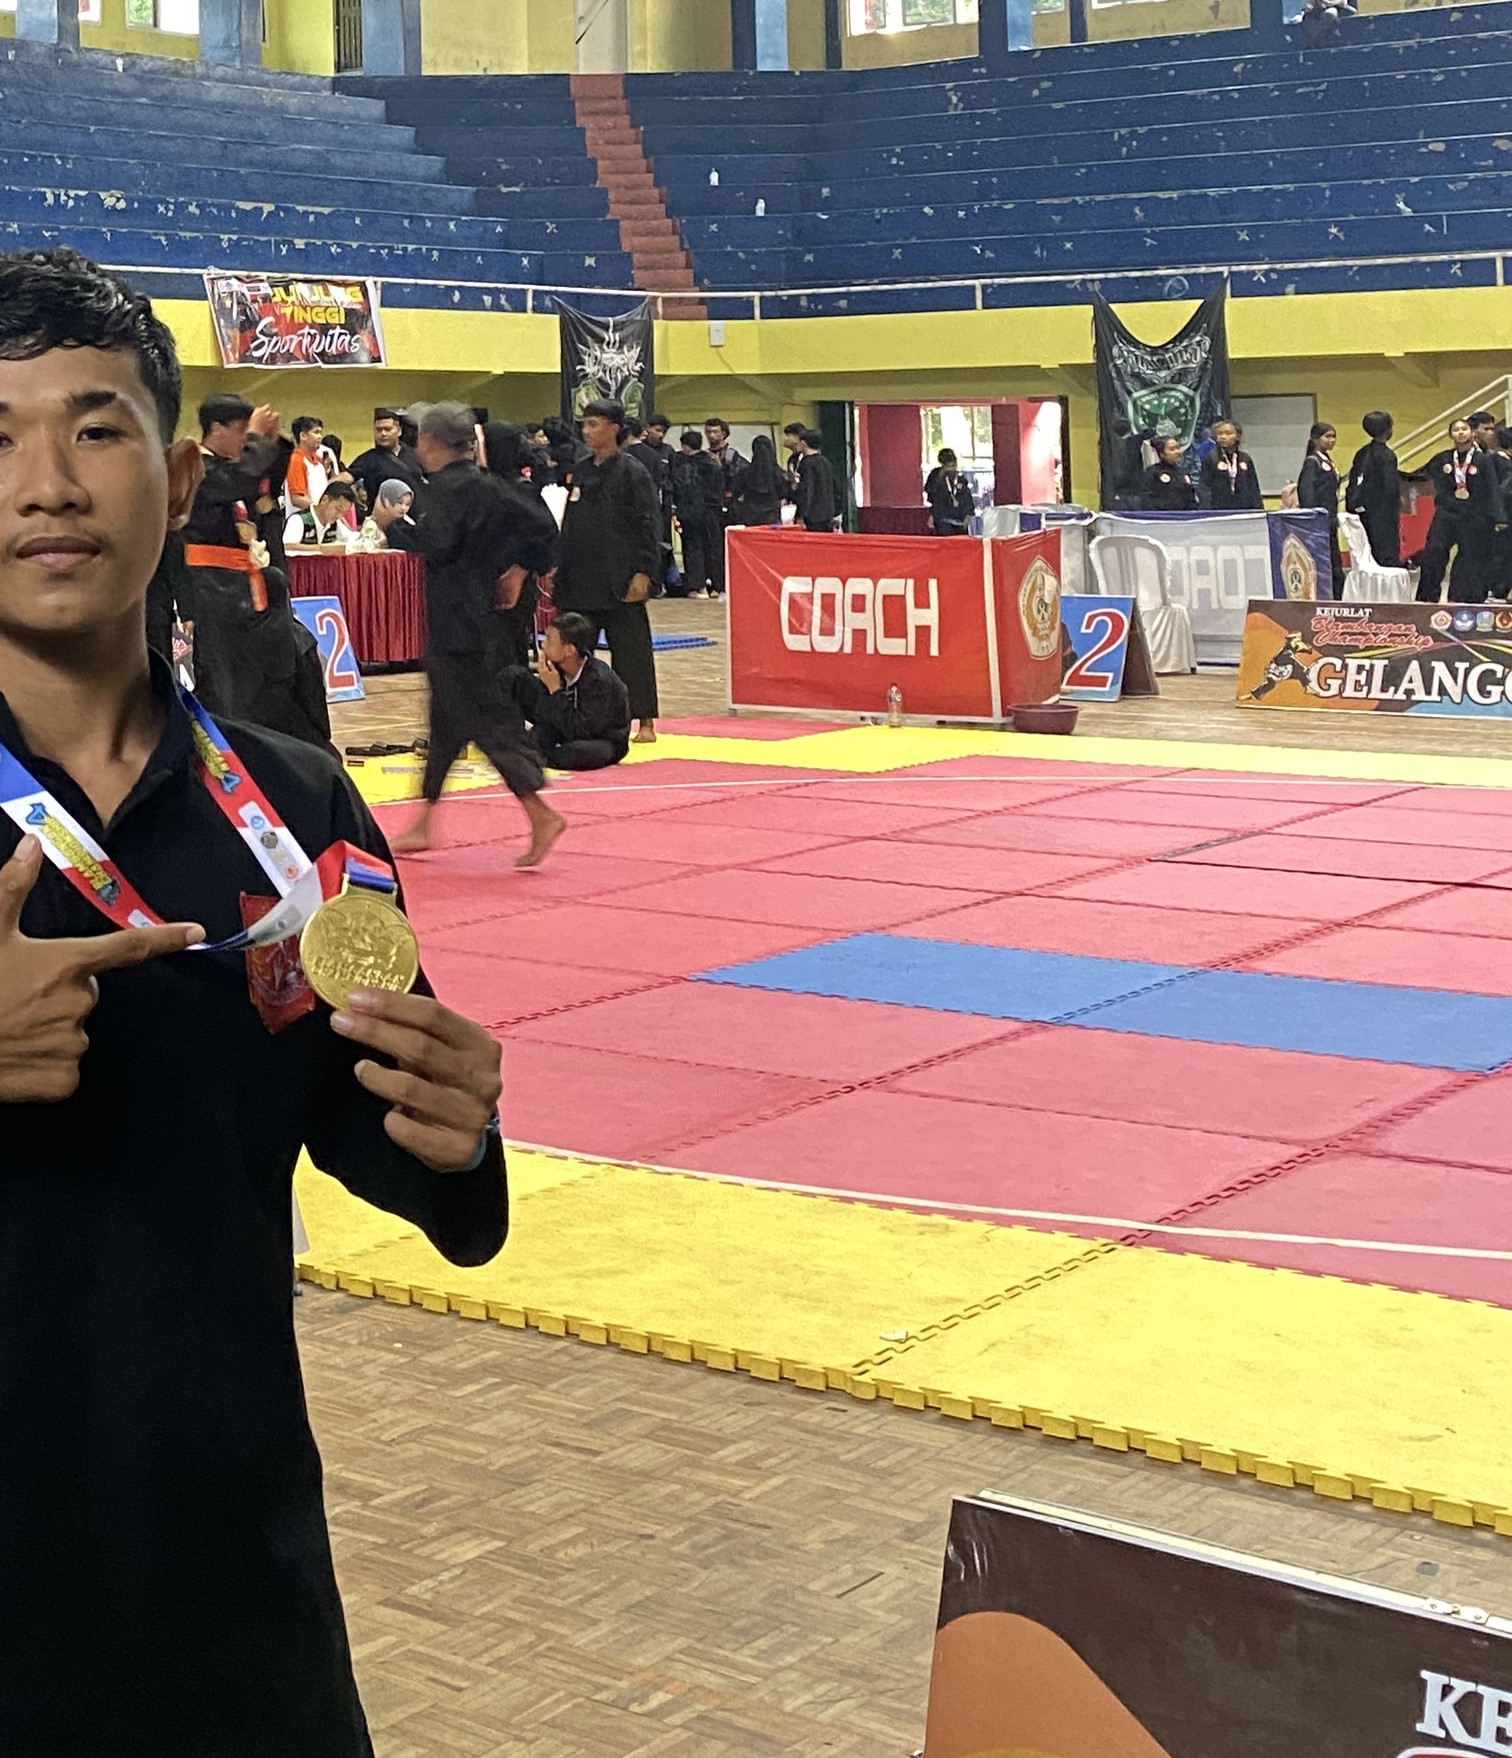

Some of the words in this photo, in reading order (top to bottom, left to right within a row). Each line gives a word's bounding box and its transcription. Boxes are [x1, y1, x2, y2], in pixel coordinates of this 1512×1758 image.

[280, 304, 346, 325] TINGGI
[250, 316, 362, 364] Sportivitas
[779, 576, 940, 657] COACH
[1315, 606, 1373, 618] KEJURLAT
[315, 608, 357, 693] 2
[1065, 608, 1131, 692] 2
[1308, 656, 1512, 705] GELANG
